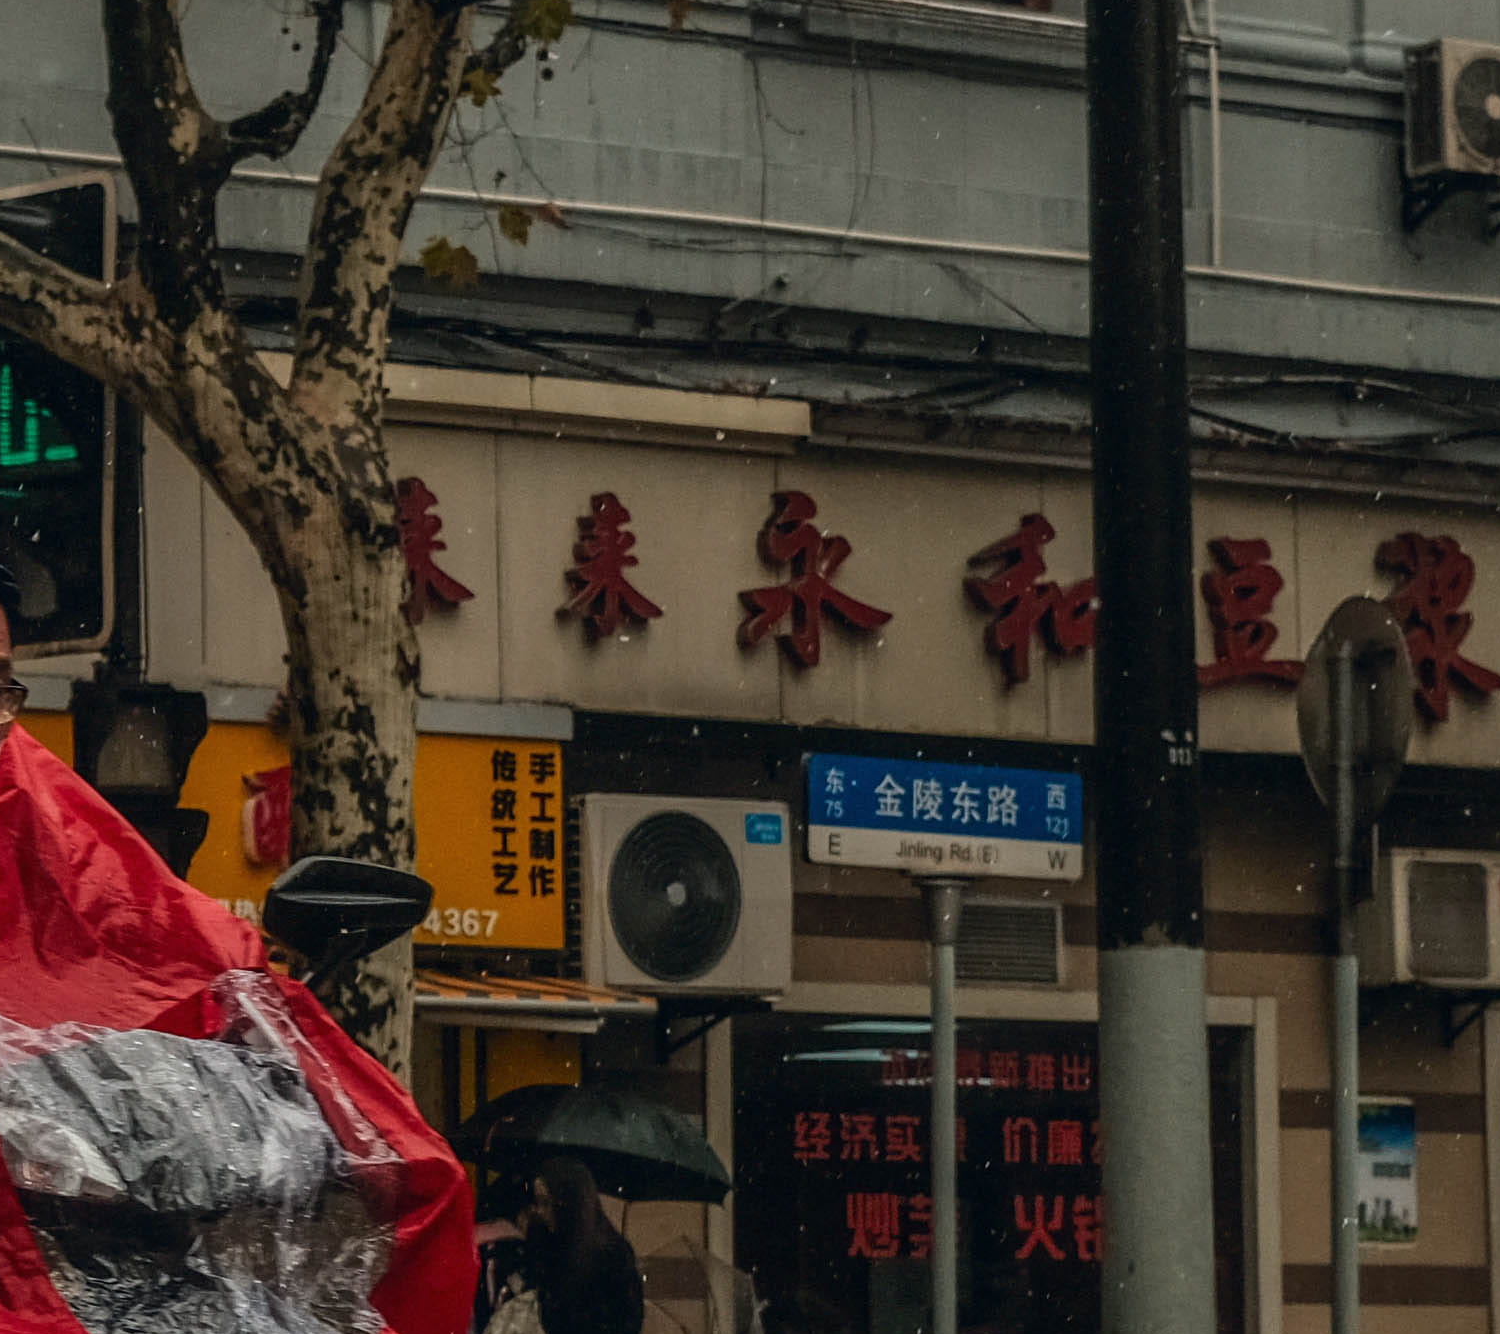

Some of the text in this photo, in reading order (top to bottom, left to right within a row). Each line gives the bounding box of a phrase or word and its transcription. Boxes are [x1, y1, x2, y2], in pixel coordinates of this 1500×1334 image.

[490, 750, 519, 896] 传统工艺
[824, 767, 1068, 827] 东 金陵东路 西
[824, 800, 845, 819] 75
[528, 752, 556, 898] 手工制作
[828, 833, 842, 856] E
[896, 842, 943, 864] Jinling
[1047, 849, 1069, 870] W
[1001, 1115, 1104, 1166] 价廉
